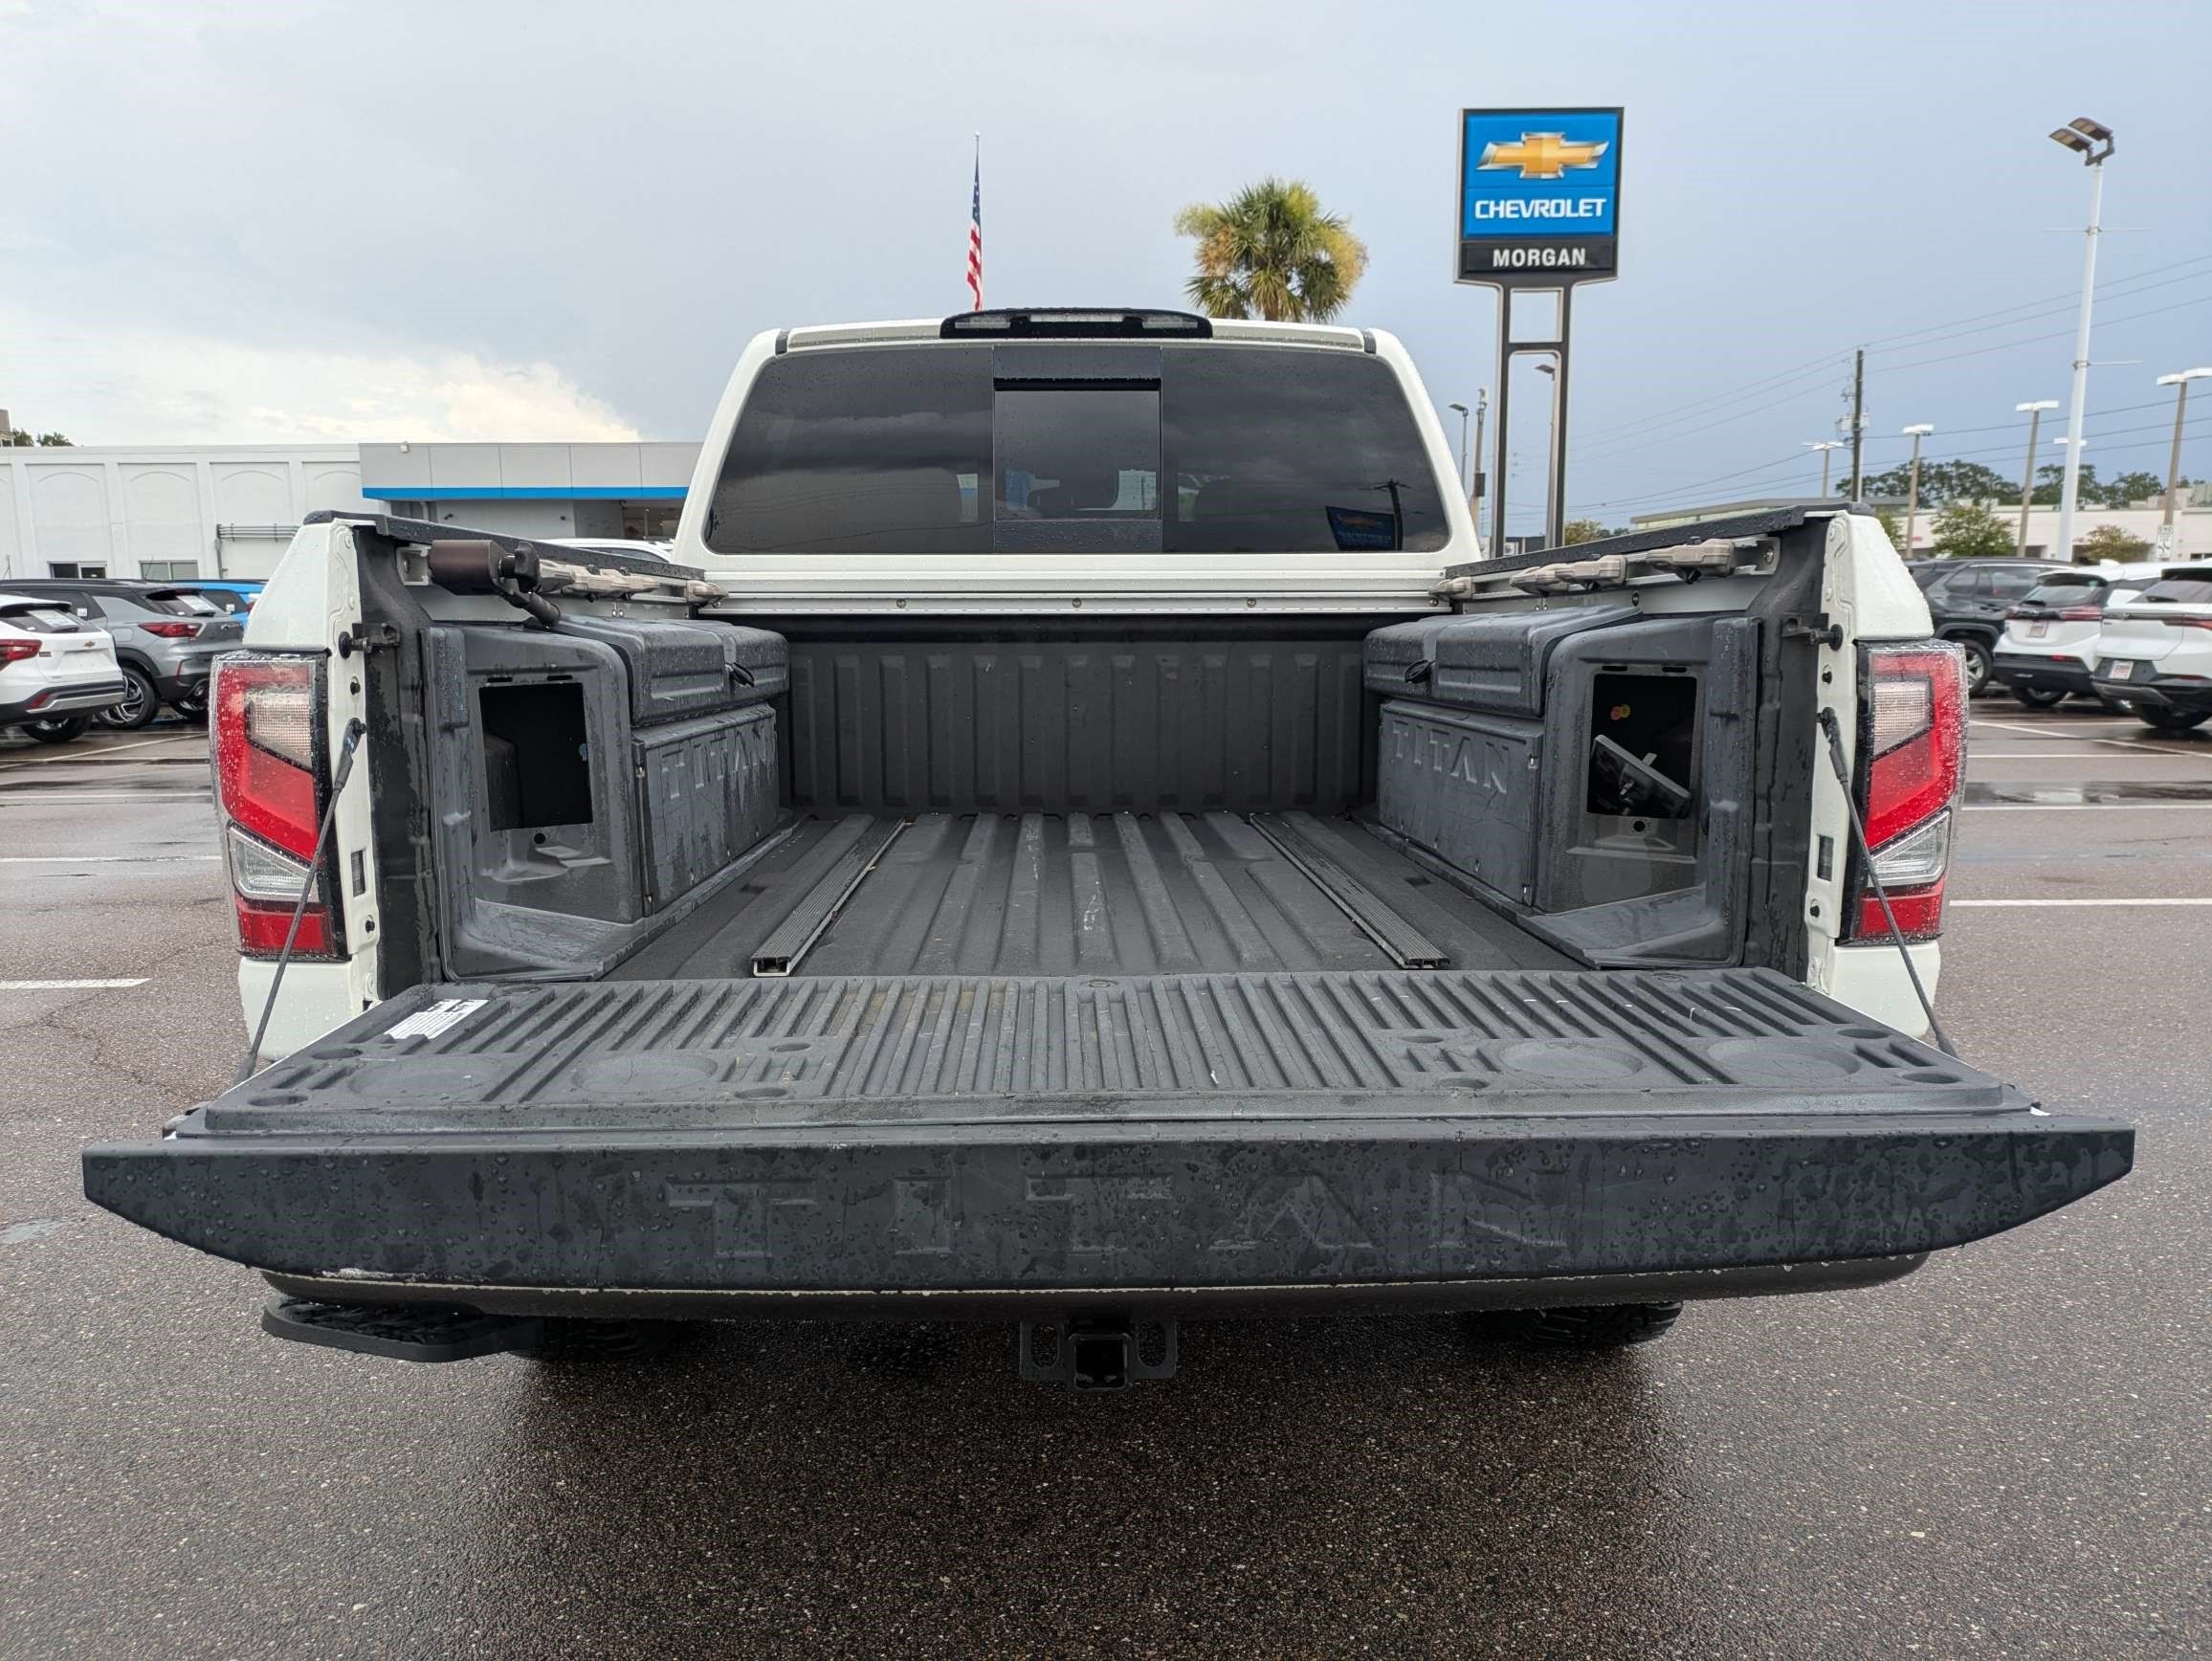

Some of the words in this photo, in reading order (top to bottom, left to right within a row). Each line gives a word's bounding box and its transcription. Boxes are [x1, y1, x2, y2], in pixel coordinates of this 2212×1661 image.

[1474, 197, 1607, 219] CHEVROLET
[1493, 248, 1586, 267] MORGAN
[661, 724, 768, 800] TITAN
[1392, 720, 1510, 794] TITAN
[667, 1169, 1570, 1259] TITAN
